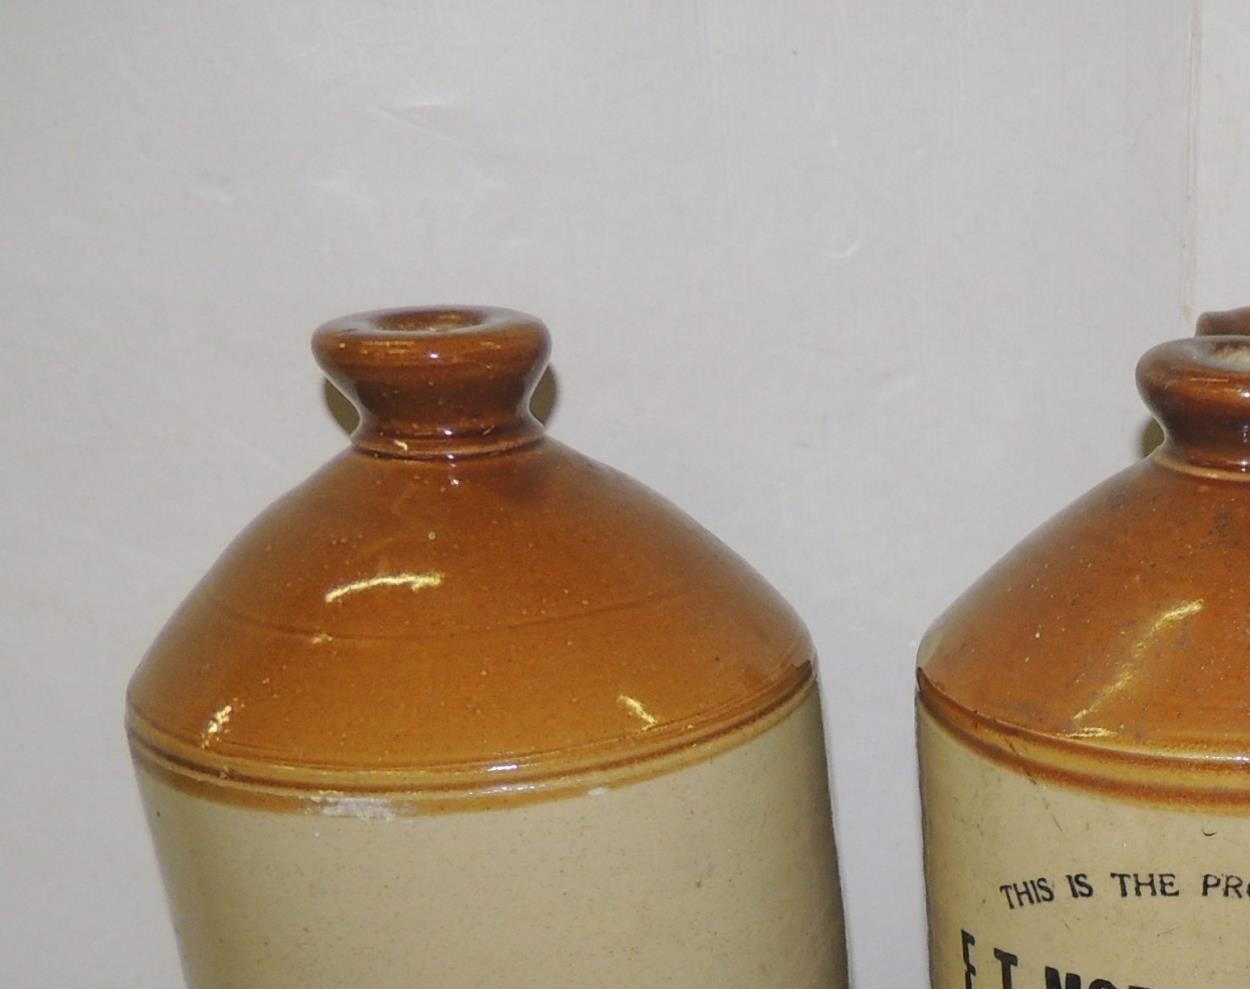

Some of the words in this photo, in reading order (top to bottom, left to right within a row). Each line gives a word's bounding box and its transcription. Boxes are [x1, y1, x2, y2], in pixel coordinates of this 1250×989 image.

[1000, 876, 1055, 911] THIS
[1066, 873, 1094, 899] IS
[1111, 872, 1180, 898] THE
